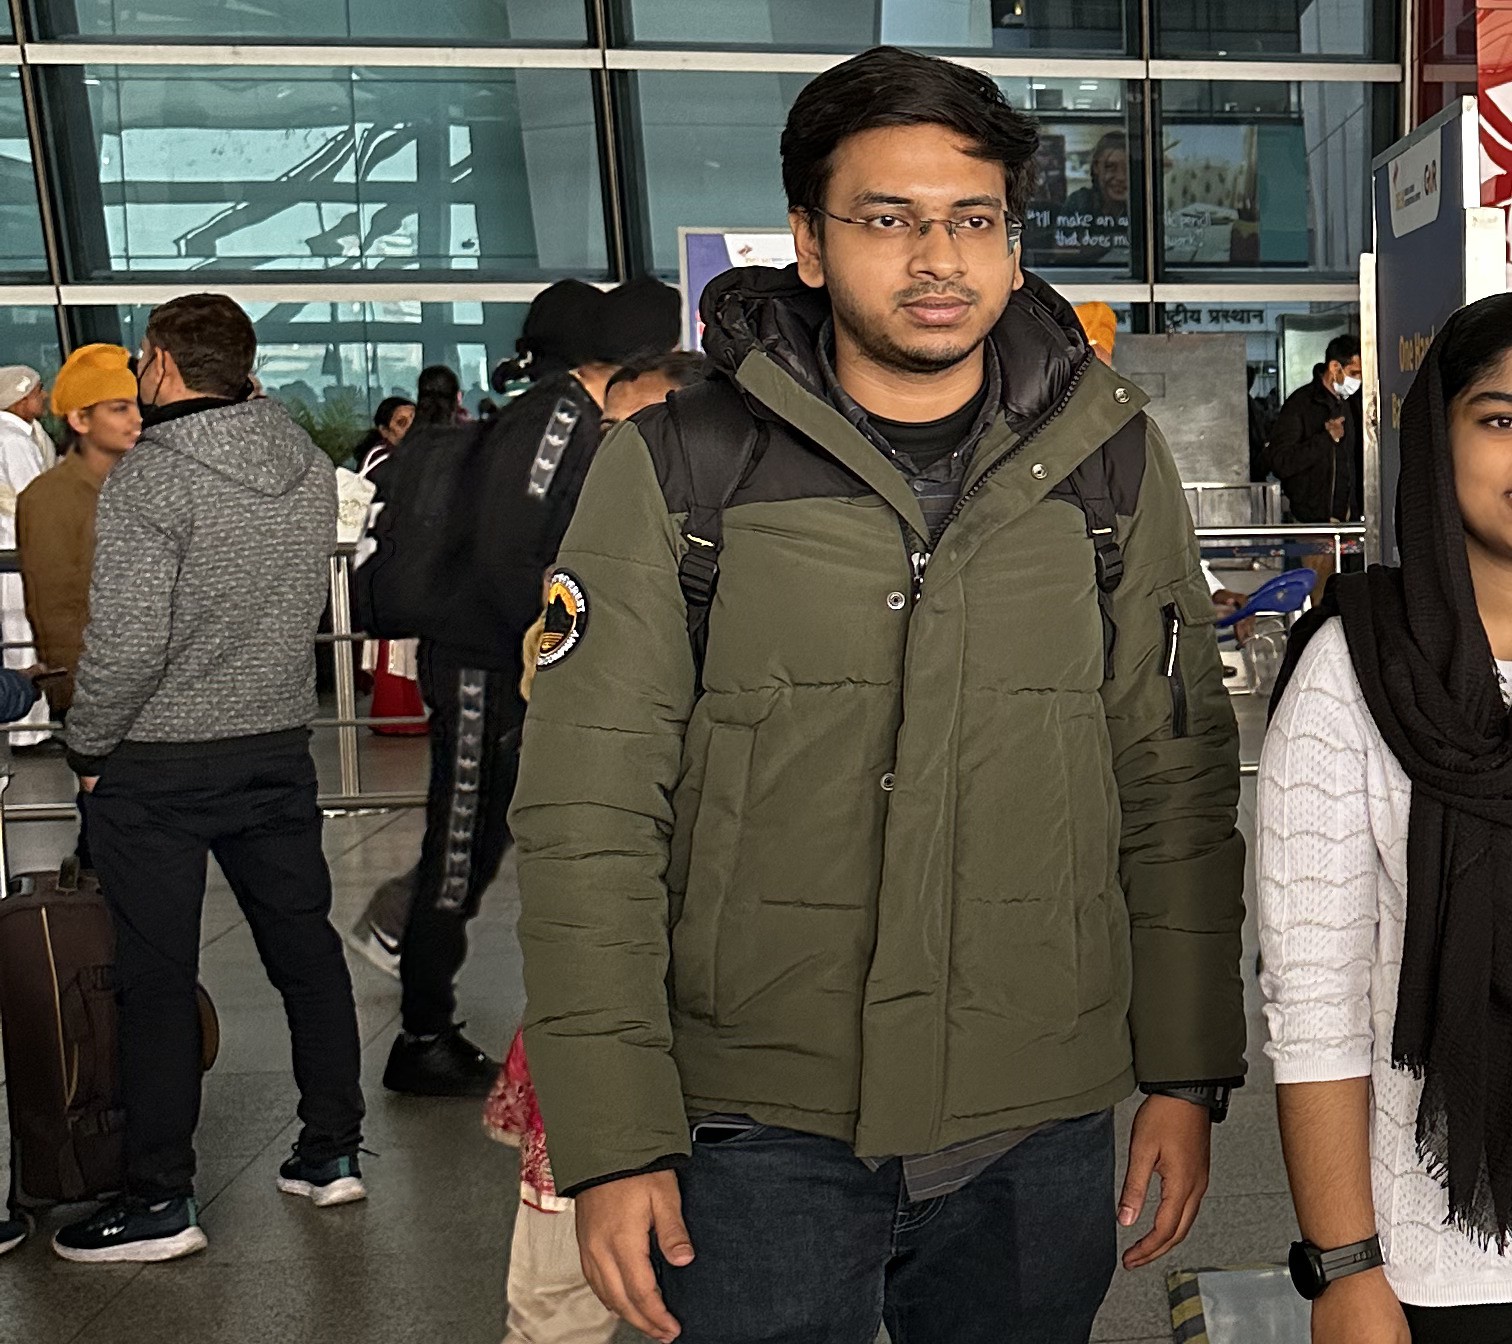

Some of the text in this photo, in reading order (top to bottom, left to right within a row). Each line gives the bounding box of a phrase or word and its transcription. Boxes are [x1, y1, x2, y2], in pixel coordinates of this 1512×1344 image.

[1057, 211, 1093, 227] make
[1096, 215, 1115, 227] an
[1055, 229, 1080, 246] that
[1082, 229, 1111, 248] does
[1208, 308, 1265, 324] प्रस्थान
[1398, 335, 1414, 372] One
